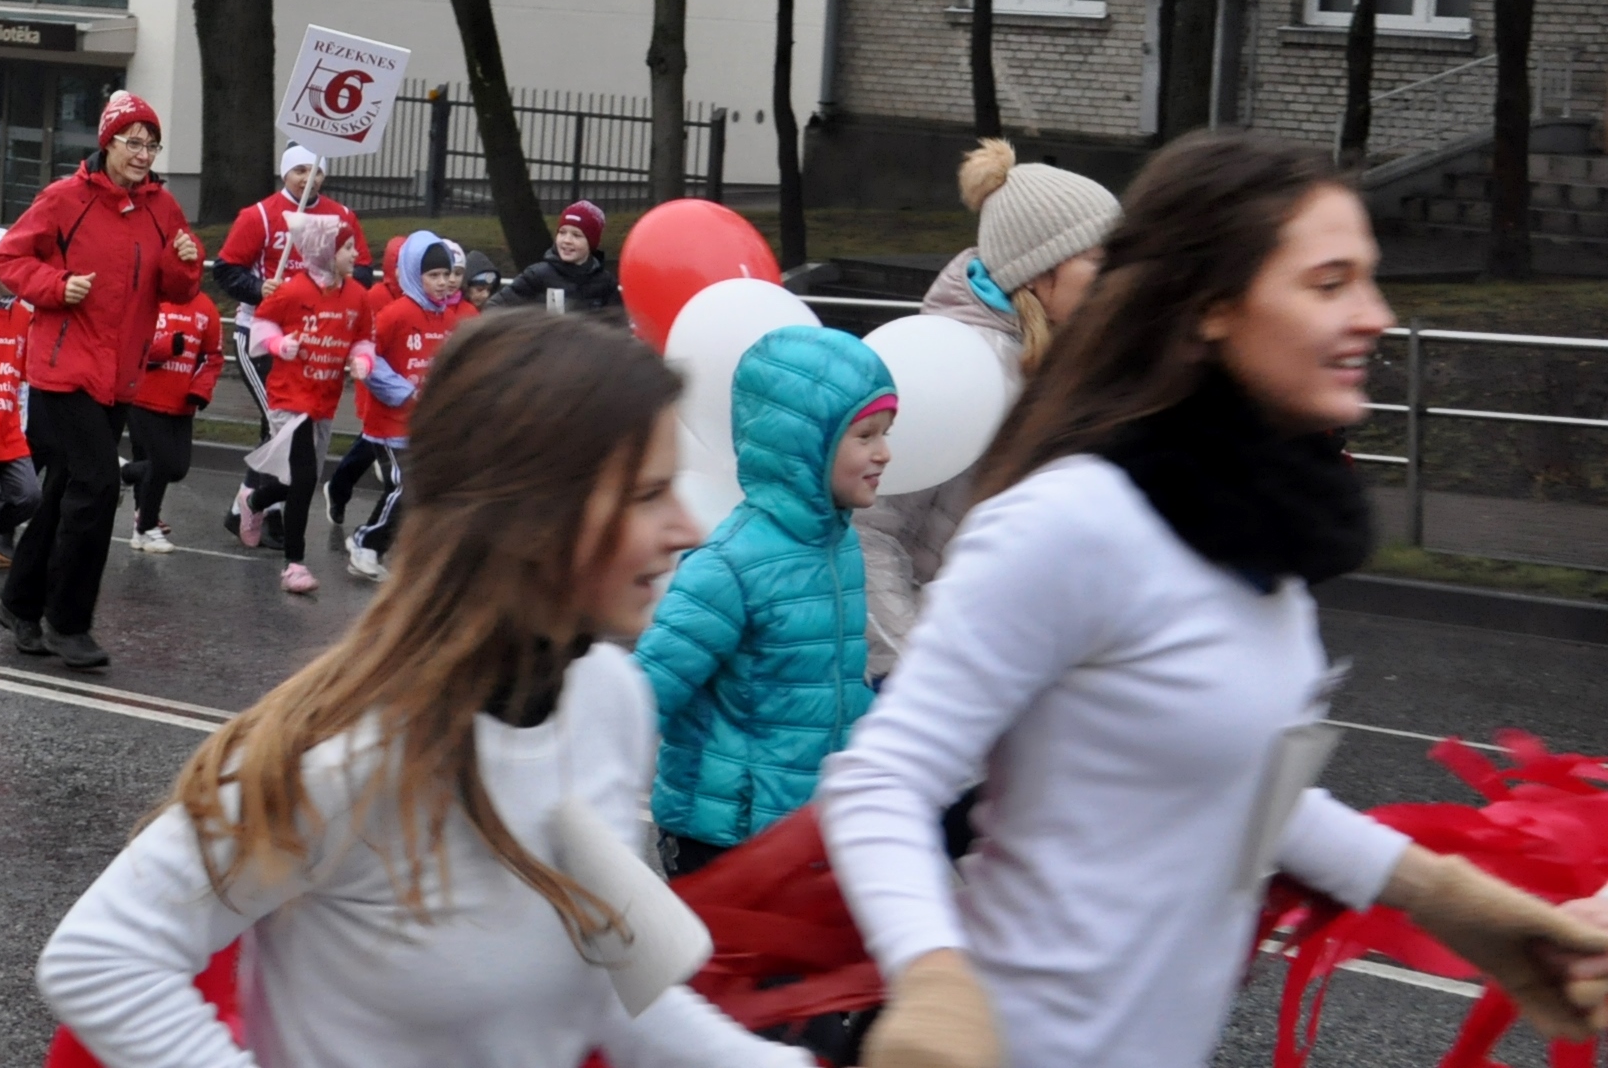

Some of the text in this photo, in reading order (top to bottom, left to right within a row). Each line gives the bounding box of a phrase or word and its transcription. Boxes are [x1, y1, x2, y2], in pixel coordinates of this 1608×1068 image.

[313, 39, 397, 71] RĒZEKNES
[324, 69, 375, 115] 6
[294, 99, 383, 134] VIDUSSKOLA
[302, 316, 318, 333] 22
[407, 333, 423, 351] 48
